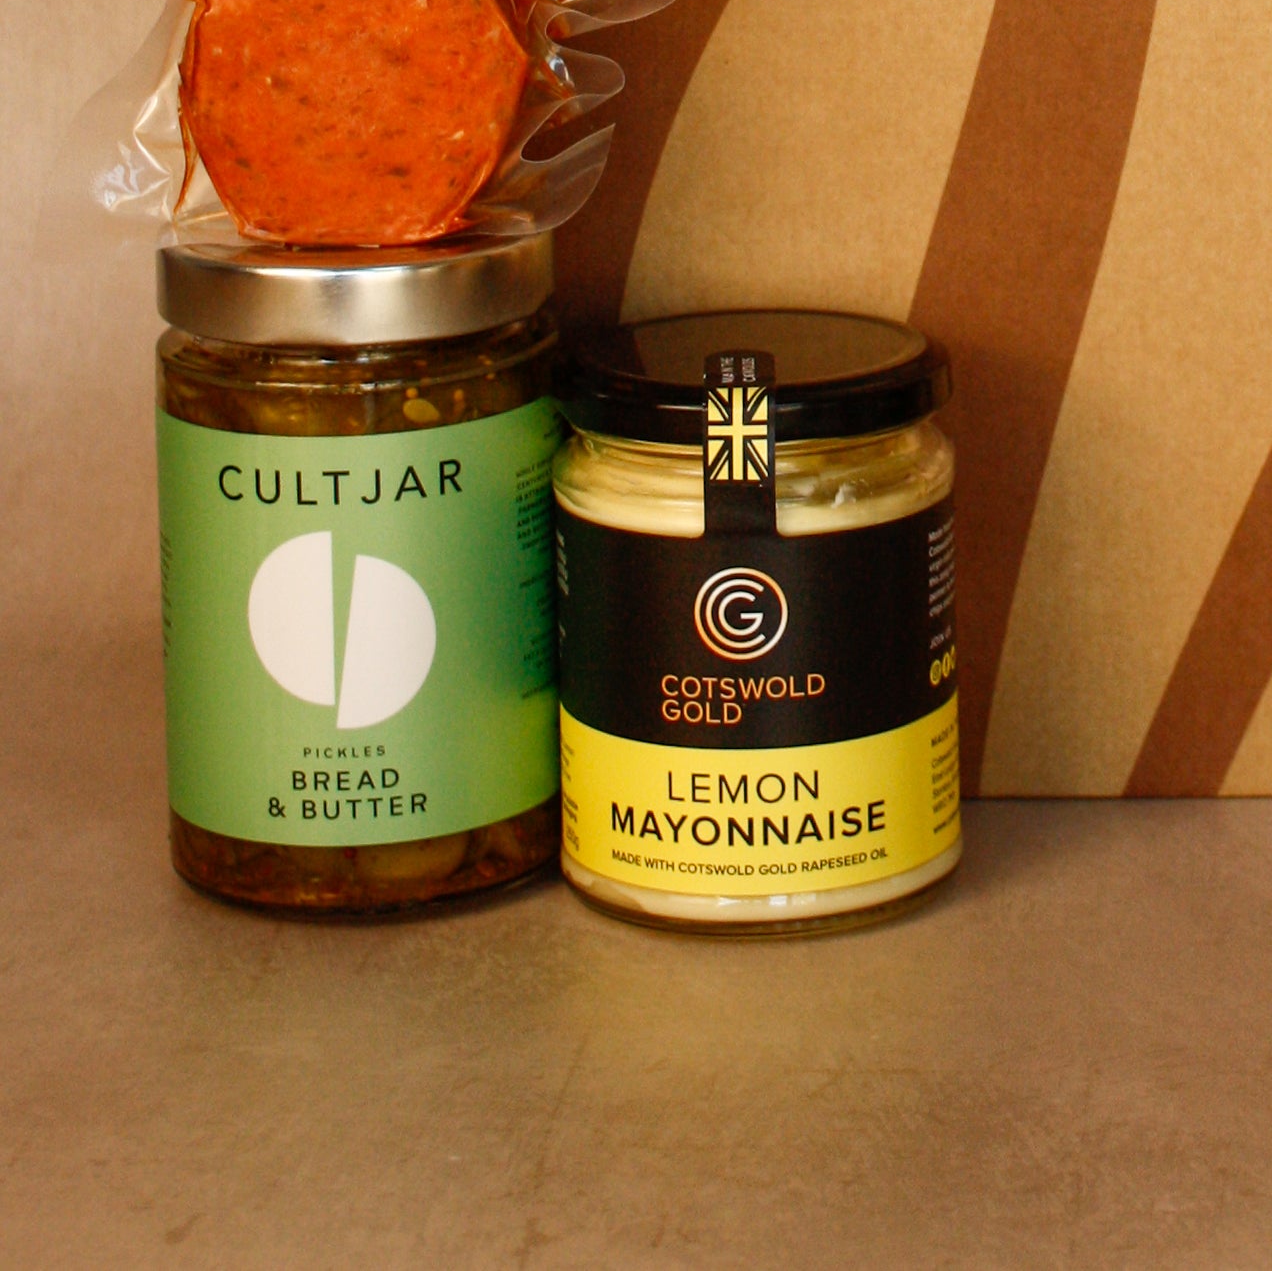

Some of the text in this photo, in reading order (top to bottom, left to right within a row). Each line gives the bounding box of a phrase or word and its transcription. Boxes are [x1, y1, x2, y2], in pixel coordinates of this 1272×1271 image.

[218, 458, 463, 505] CULTJAR
[661, 673, 826, 700] COTSWOLD
[662, 699, 743, 724] GOLD
[303, 744, 386, 759] PICKLES
[291, 767, 400, 791] BREAD
[668, 769, 819, 804] LEMON
[268, 792, 428, 820] & BUTTER
[611, 799, 886, 846] MAYONNAISE
[611, 847, 888, 876] MADE WITH COTSWOLD GOLD RAPESEED OIL
